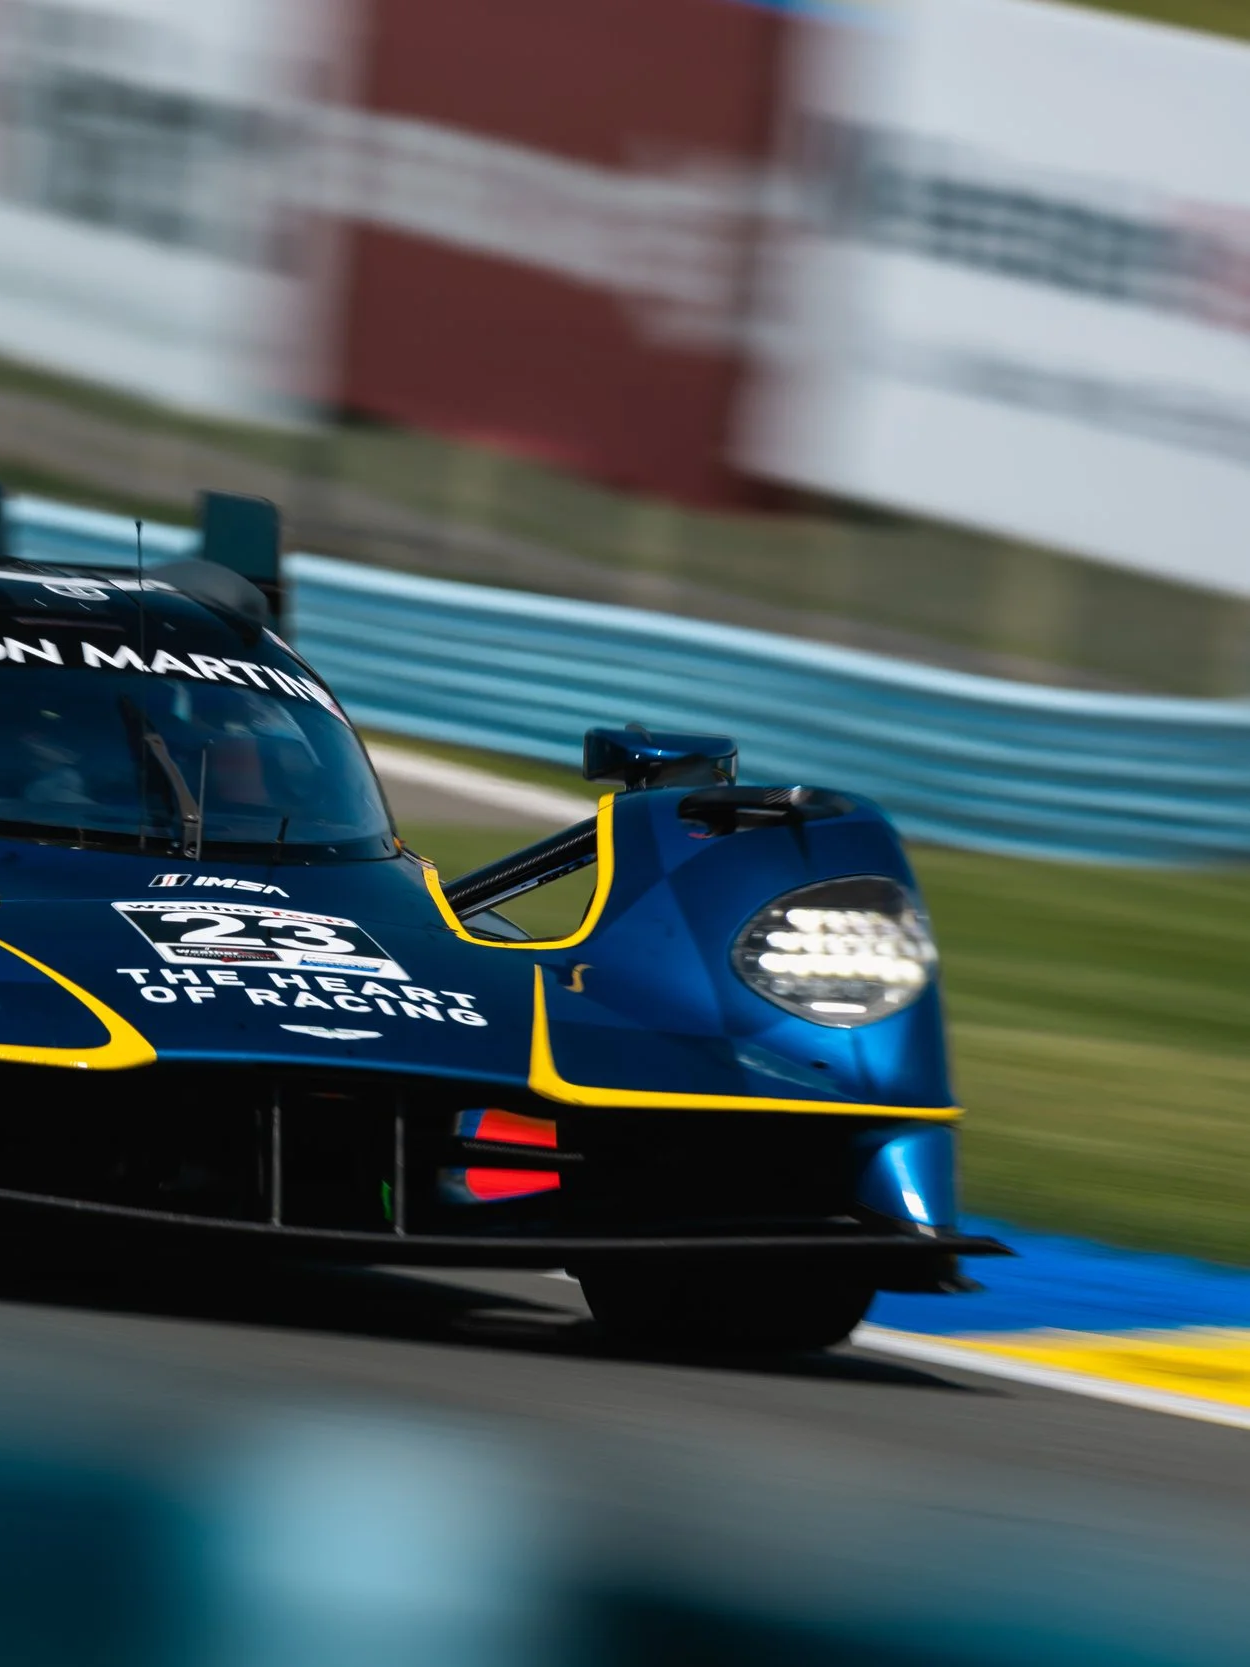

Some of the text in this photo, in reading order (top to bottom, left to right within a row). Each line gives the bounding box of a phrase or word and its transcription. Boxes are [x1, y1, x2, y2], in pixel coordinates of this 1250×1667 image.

[81, 642, 336, 710] MARTIN
[193, 876, 290, 898] IMSA
[160, 912, 356, 953] 23
[117, 968, 477, 1008] THE HEART
[140, 985, 488, 1027] OF RACING
